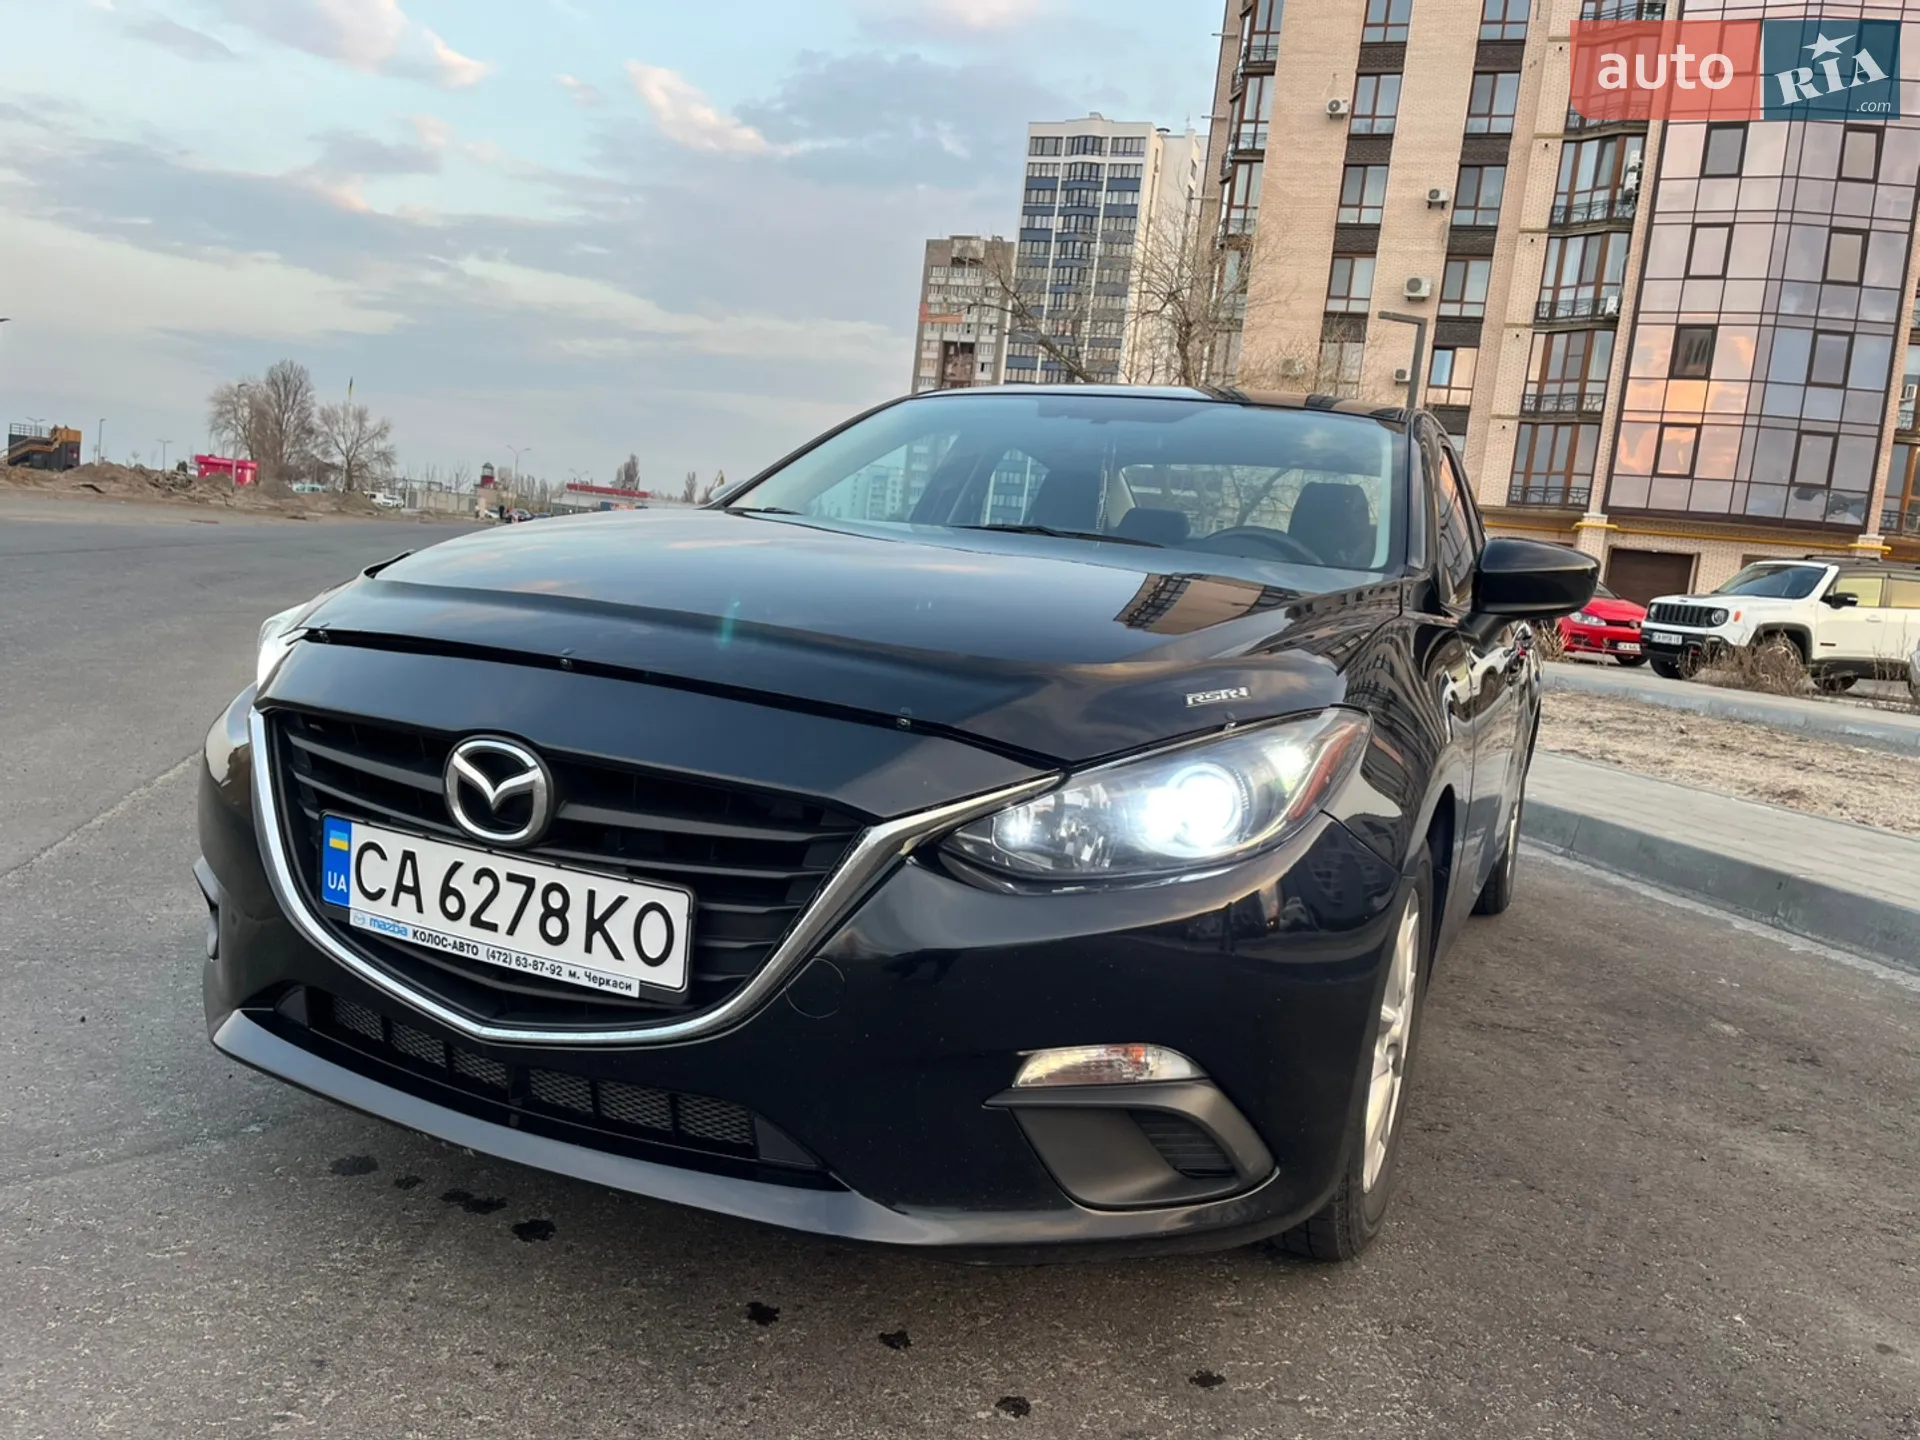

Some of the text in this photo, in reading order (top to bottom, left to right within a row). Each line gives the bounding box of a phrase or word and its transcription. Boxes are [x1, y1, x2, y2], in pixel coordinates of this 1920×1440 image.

[327, 871, 348, 893] UA
[369, 917, 408, 937] mazda
[412, 929, 479, 956] КОЛОС-АВТО
[486, 947, 512, 966] (472)
[515, 955, 563, 977] 63-87-92
[584, 970, 632, 992] Черкаси
